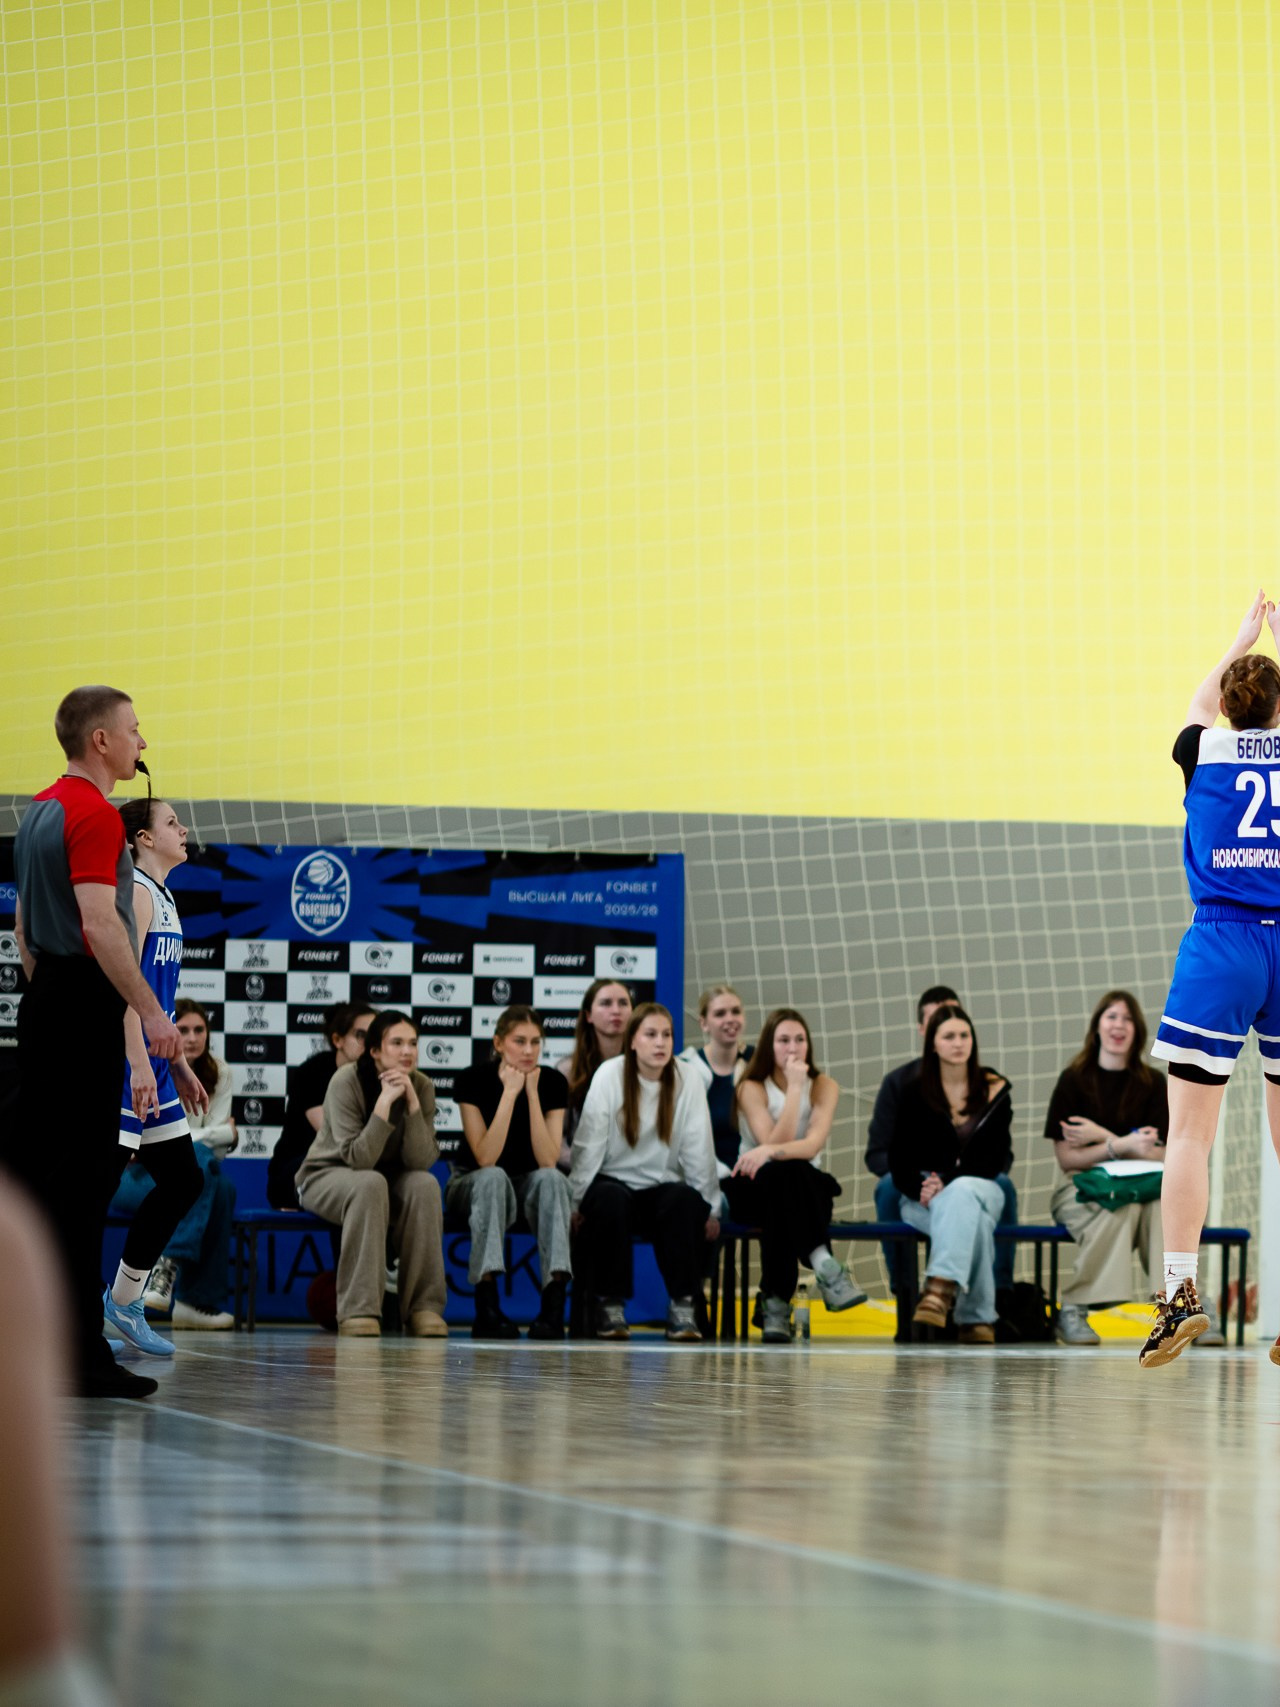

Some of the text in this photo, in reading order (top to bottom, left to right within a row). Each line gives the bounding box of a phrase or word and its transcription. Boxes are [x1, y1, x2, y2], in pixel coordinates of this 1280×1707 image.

[182, 947, 215, 960] ONBET
[297, 950, 340, 962] FONBET
[421, 952, 464, 965] FONBET
[543, 954, 586, 967] FONBET
[420, 1015, 463, 1027] FONBET
